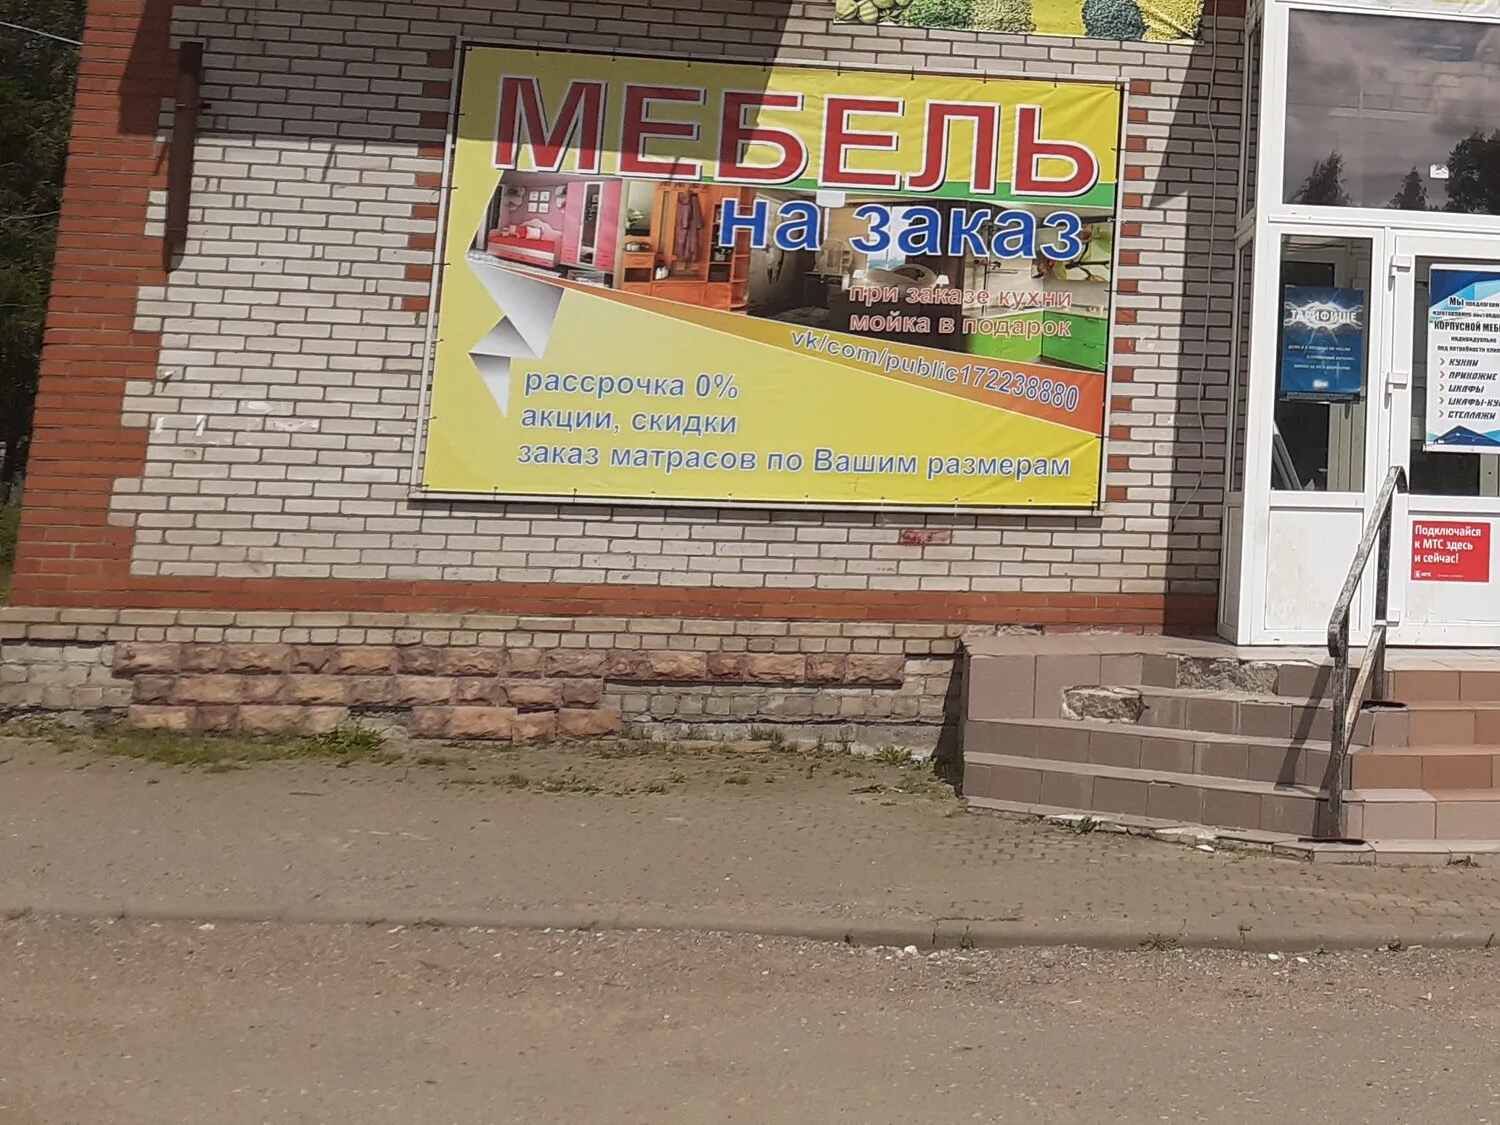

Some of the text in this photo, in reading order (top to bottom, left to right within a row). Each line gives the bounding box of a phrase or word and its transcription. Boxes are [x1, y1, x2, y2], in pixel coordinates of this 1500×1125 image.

[491, 75, 1102, 197] МЕБЕЛЬ
[719, 196, 1083, 260] на заказ
[849, 285, 1072, 311] при заказе кухни
[1449, 297, 1464, 306] Мы
[849, 309, 1071, 340] мойка в подарок
[1434, 320, 1481, 331] КОРПУСНОЙ
[1449, 358, 1479, 367] КУХНИ
[790, 329, 1080, 412] vk/com/public172238880
[1448, 371, 1498, 381] ПРИХОЖИЕ
[524, 372, 738, 399] рассрочка 0%
[1448, 384, 1485, 393] ШКАФЫ
[1448, 410, 1497, 420] СТЕЛЛАЖИ
[521, 408, 738, 435] акции, скидки
[517, 444, 1071, 481] заказ матрасов по Вашим размерам
[1415, 525, 1481, 537] Подключайся
[1414, 539, 1473, 551] к МТС здесь
[1414, 553, 1459, 564] и сейчас!
